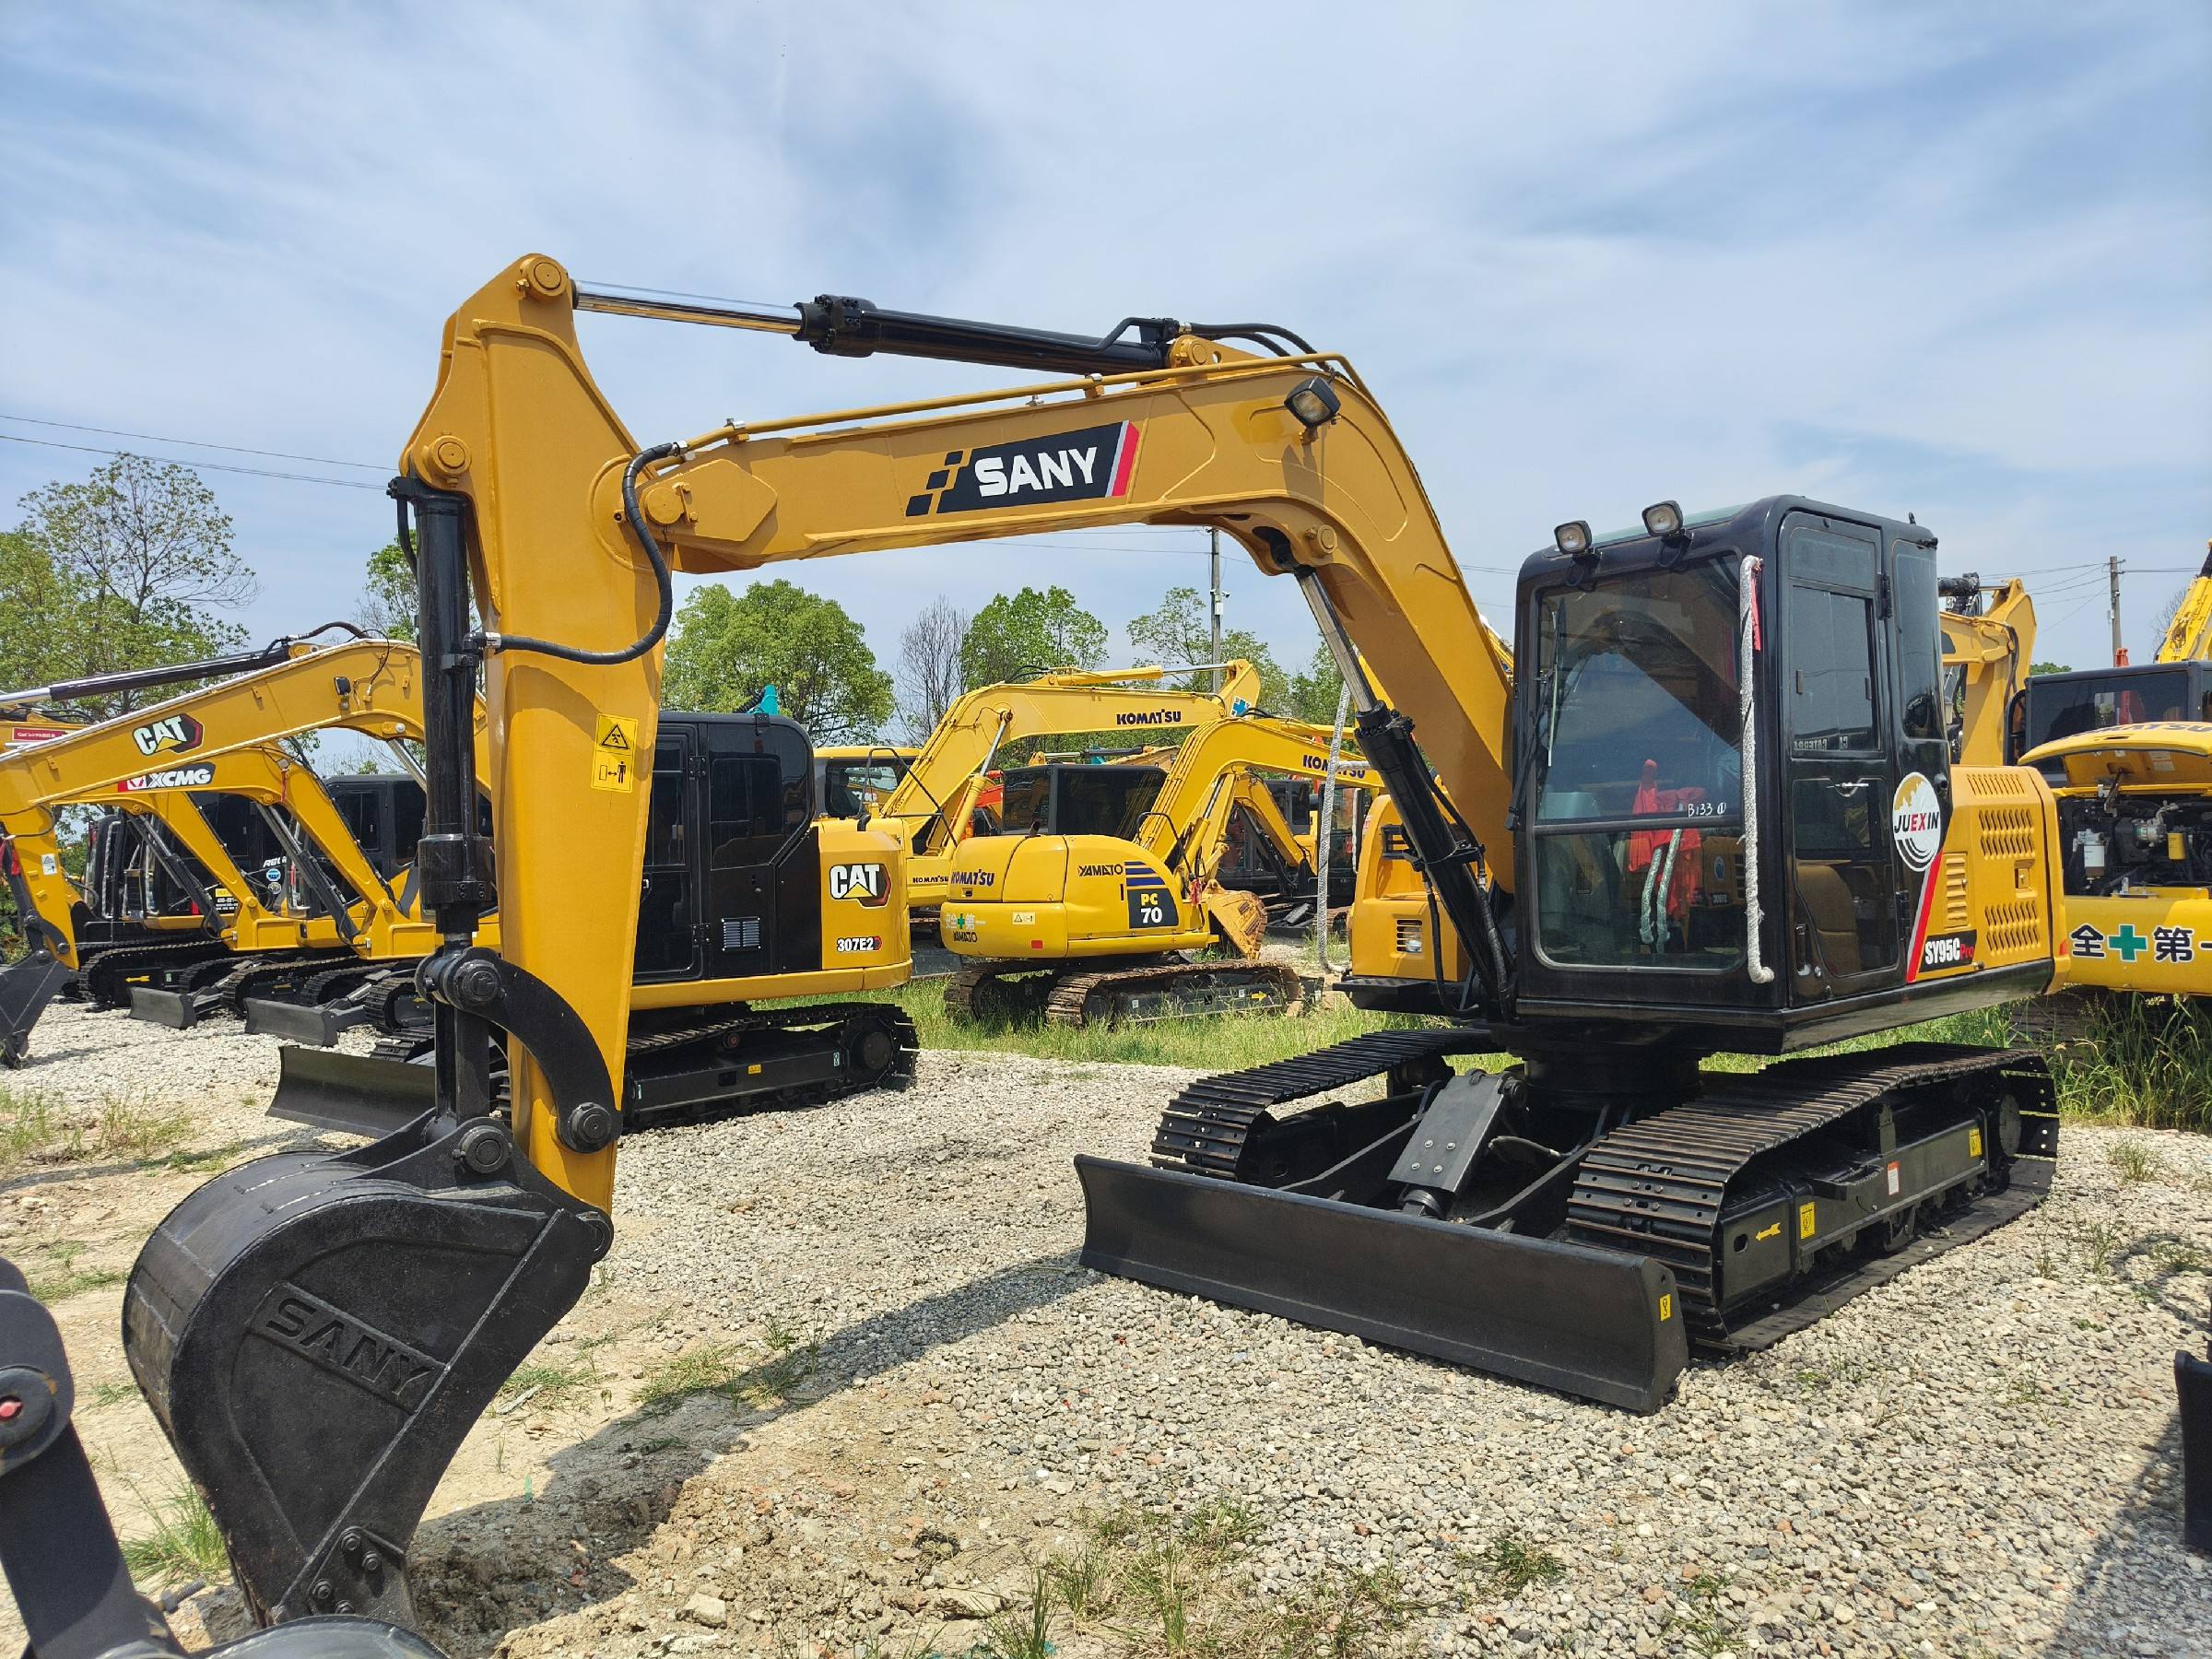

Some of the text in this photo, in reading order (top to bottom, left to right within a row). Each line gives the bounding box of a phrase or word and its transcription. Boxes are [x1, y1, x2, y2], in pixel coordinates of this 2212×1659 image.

[974, 446, 1098, 498] SANY
[1116, 709, 1182, 725] KOMATSU
[133, 715, 187, 755] CAT
[147, 768, 212, 789] XCMG
[1688, 803, 1712, 818] B133
[1894, 811, 1940, 834] JUEXIN
[912, 875, 949, 883] KOMATSU
[950, 869, 995, 887] KOMATSU
[1077, 864, 1124, 877] YAMATO
[830, 864, 880, 900] CAT
[1140, 893, 1159, 906] PC
[1140, 907, 1163, 924] 70
[837, 936, 874, 952] 307E2
[265, 1297, 436, 1396] SANY
